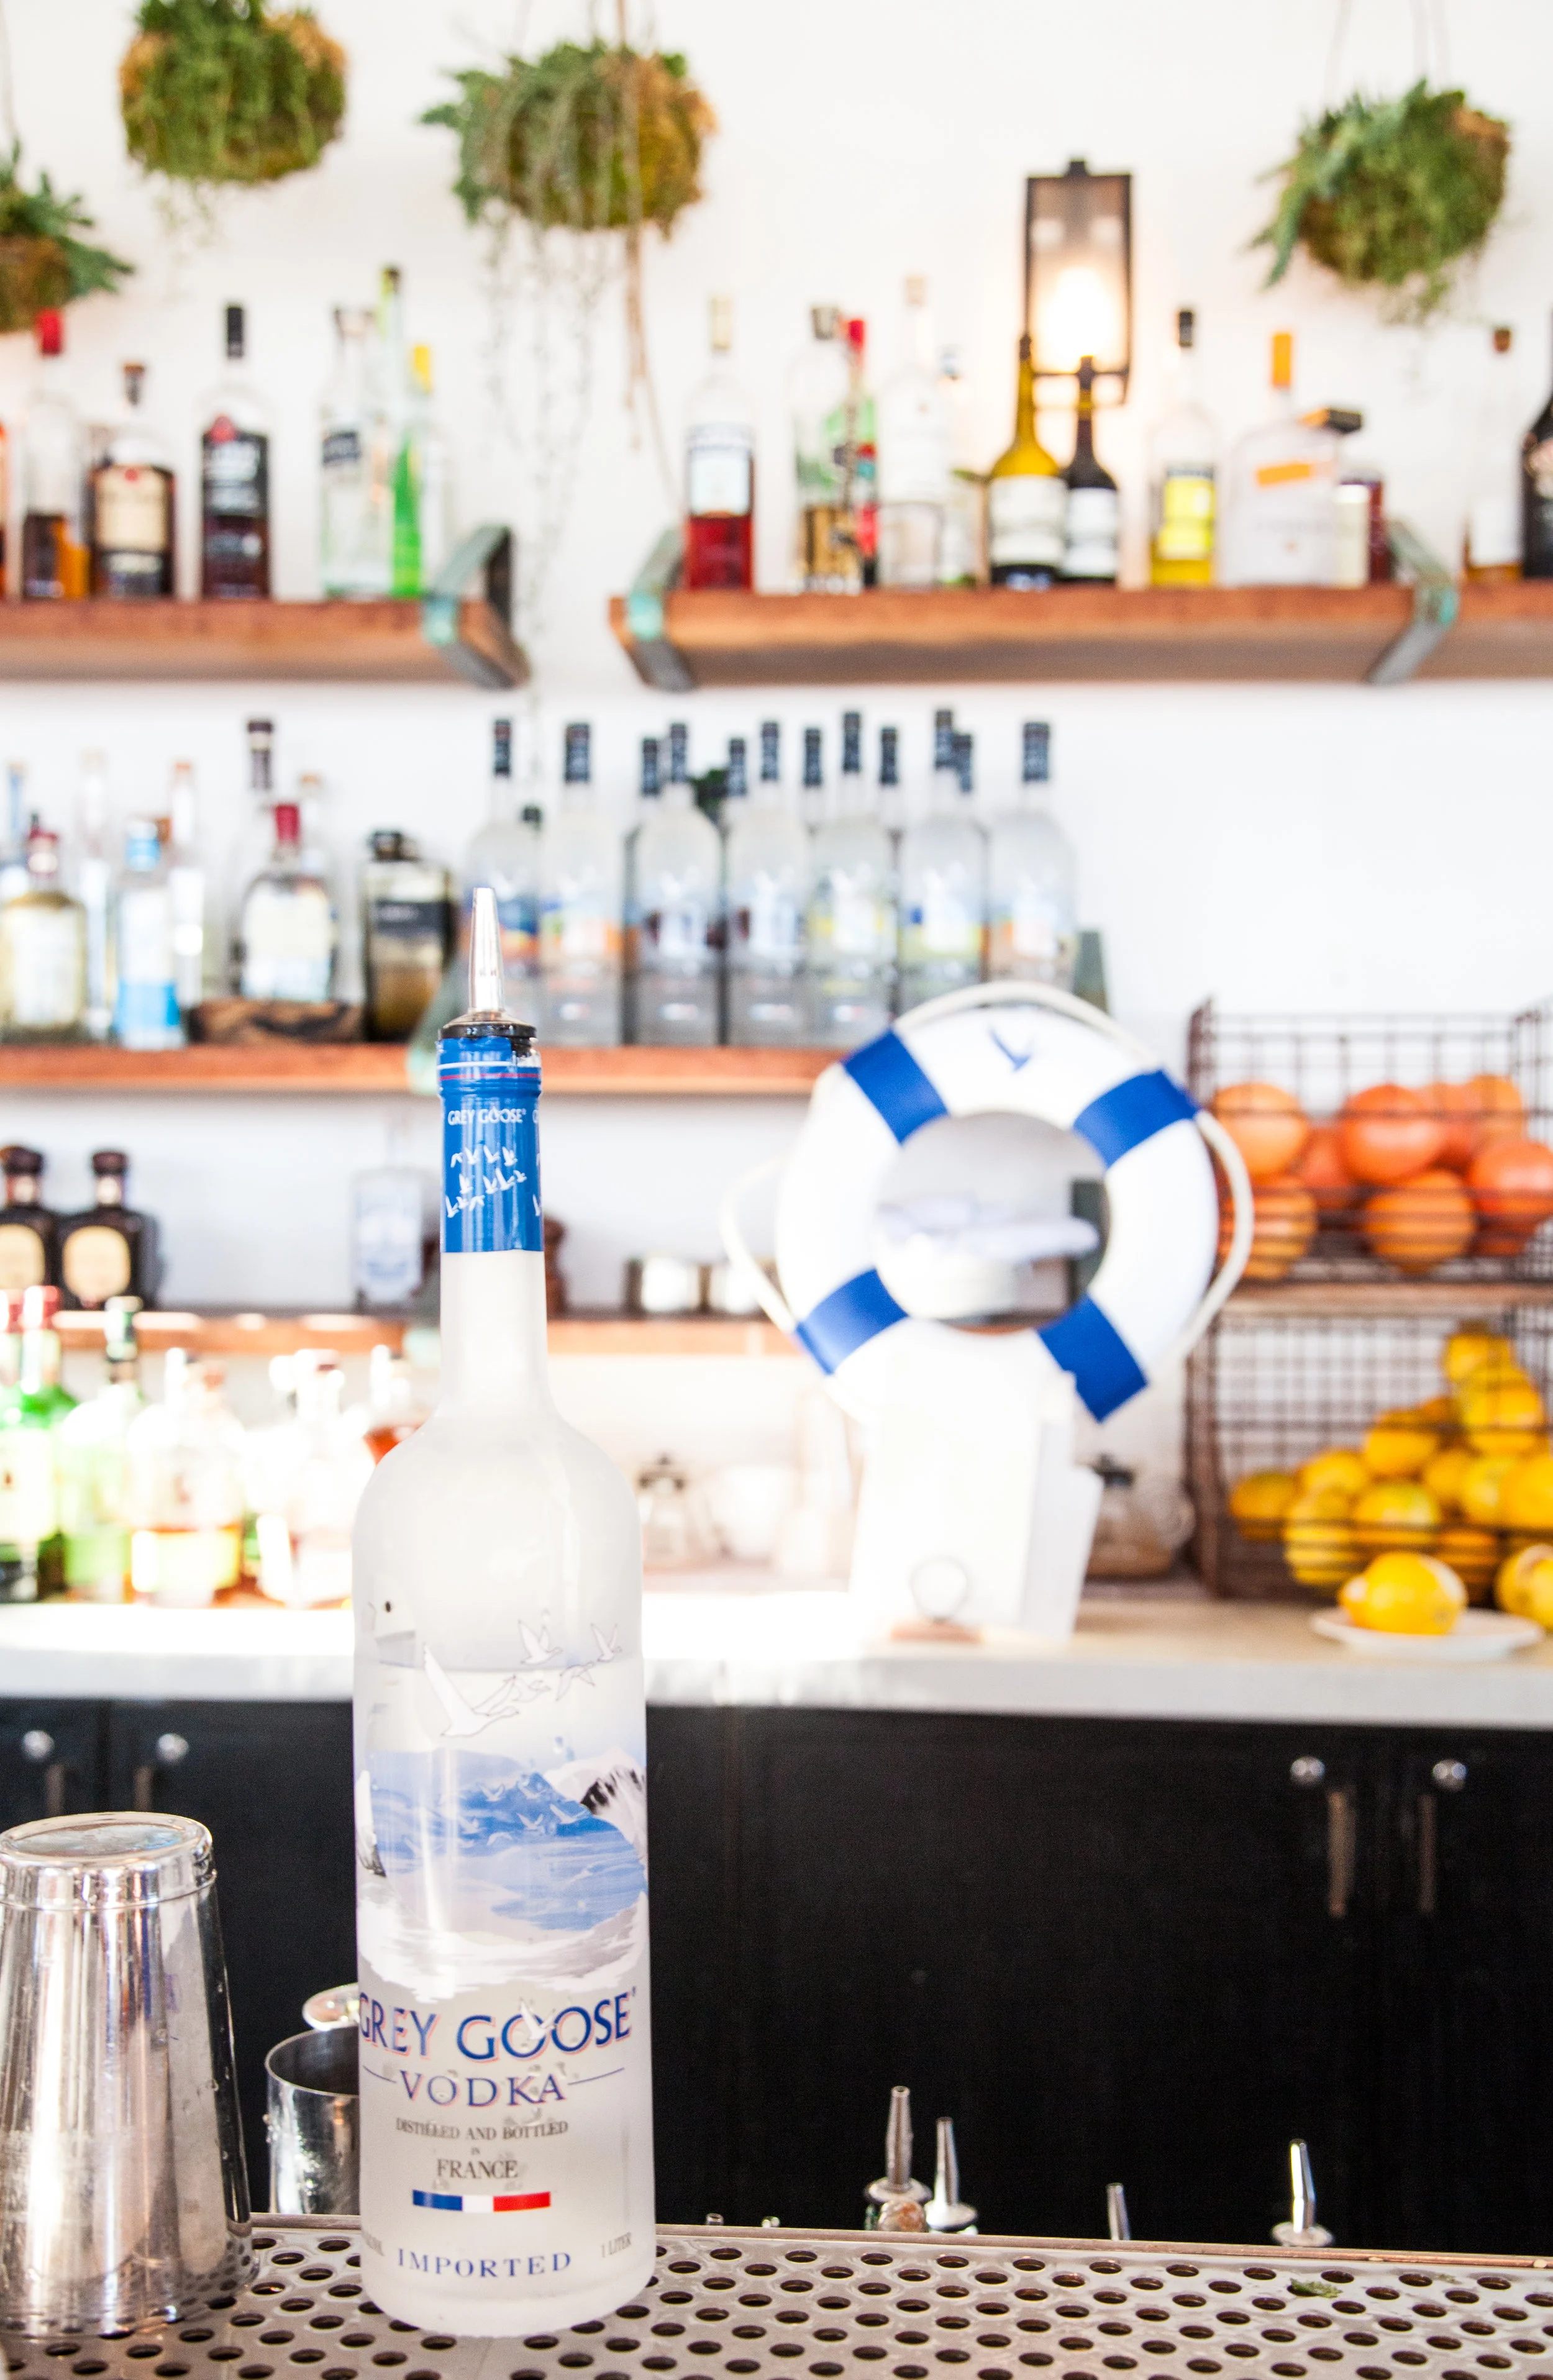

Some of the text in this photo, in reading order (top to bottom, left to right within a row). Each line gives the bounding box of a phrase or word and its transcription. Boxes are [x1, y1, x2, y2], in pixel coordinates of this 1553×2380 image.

[448, 1109, 475, 1125] GREY
[359, 1992, 441, 2060] GREY
[399, 2069, 567, 2107] VODKA
[396, 2117, 568, 2140] DISTILLED AND BOTTLED
[437, 2158, 518, 2179] FRANCE
[398, 2248, 572, 2278] IMPORTED
